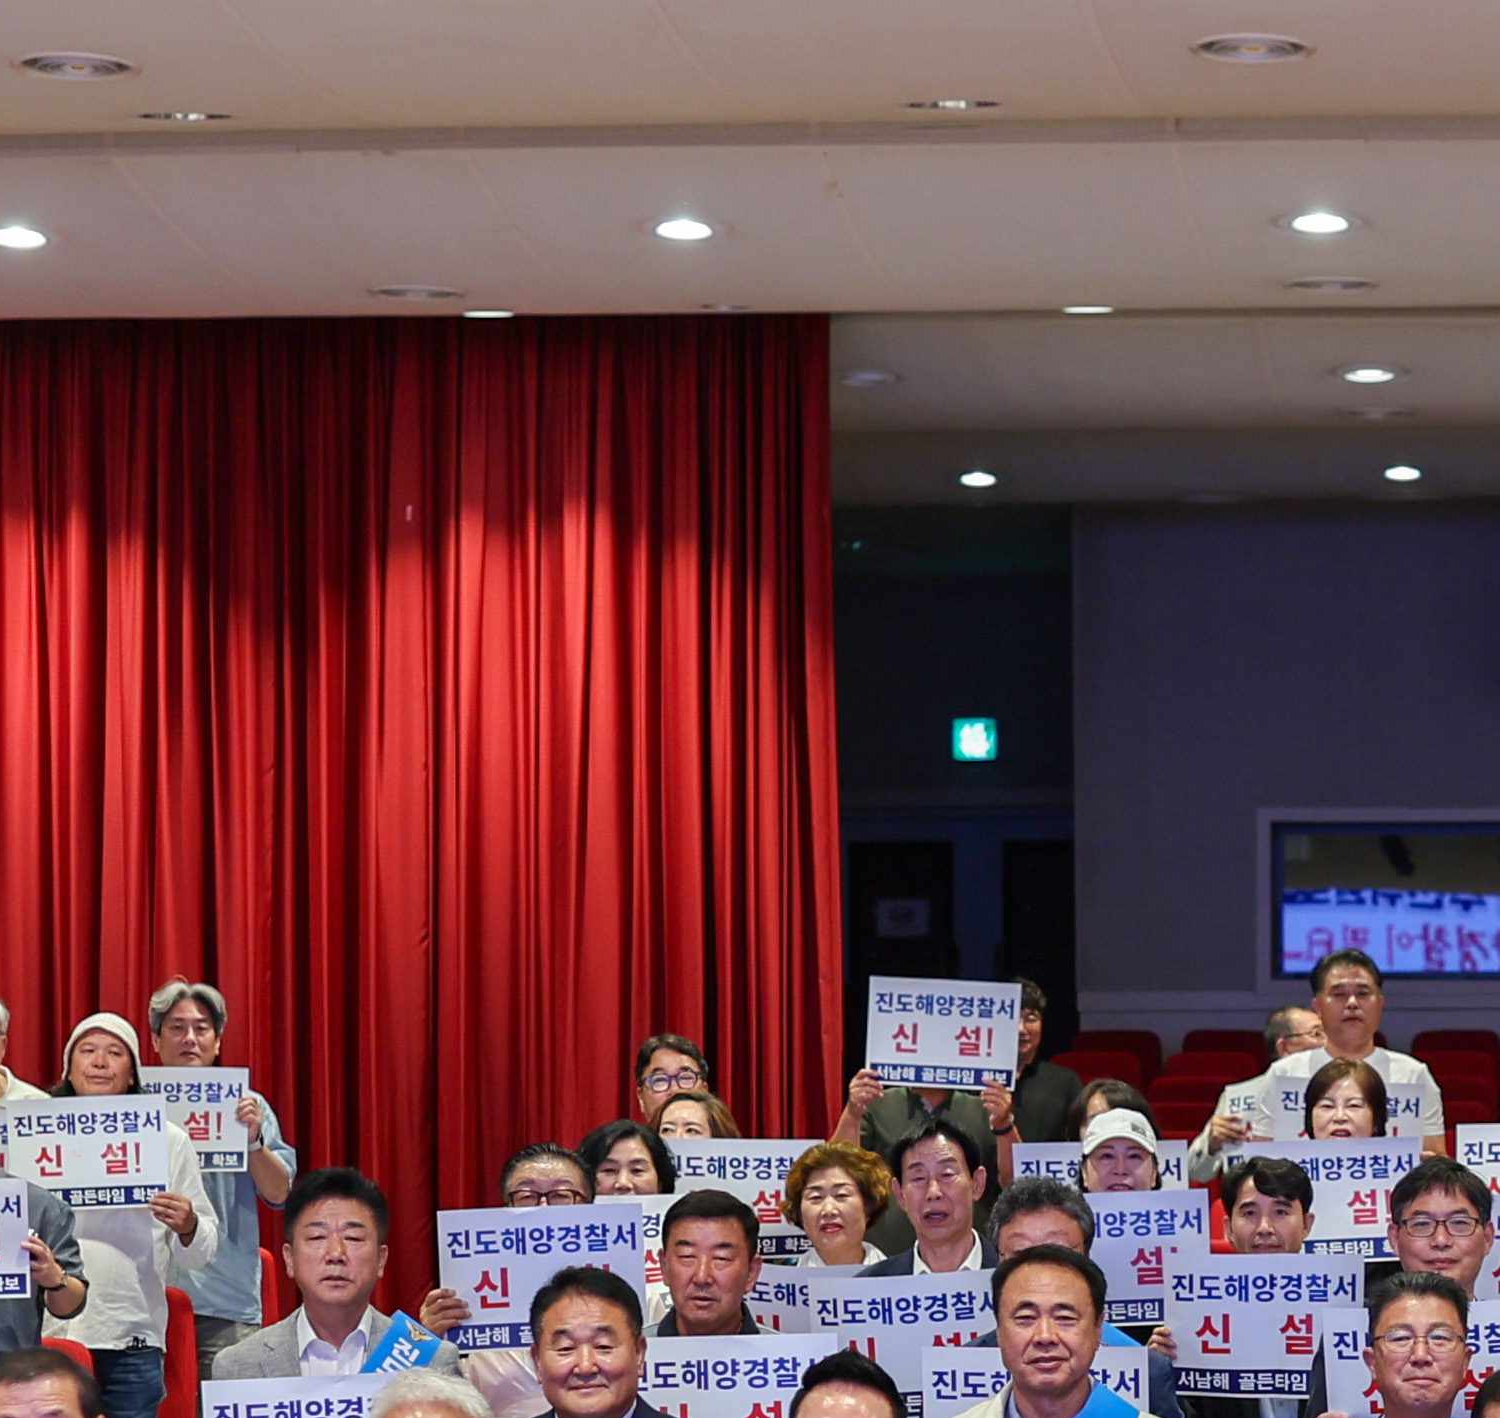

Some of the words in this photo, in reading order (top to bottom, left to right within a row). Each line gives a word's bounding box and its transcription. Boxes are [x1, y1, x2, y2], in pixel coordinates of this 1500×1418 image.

[875, 991, 1015, 1020] 진도해양경찰서
[891, 1022, 919, 1054] 신
[954, 1025, 994, 1057] 설!
[921, 1067, 975, 1084] 골든타임
[13, 1109, 161, 1138] 진도해양경찰서
[35, 1144, 63, 1177] 신
[100, 1141, 141, 1175] 설!
[69, 1188, 126, 1205] 골든타임
[446, 1221, 637, 1259] 진도해양경찰서
[1171, 1273, 1357, 1303] 진도해양경찰서
[455, 1326, 510, 1347] 서남해
[1177, 1370, 1230, 1391] 서남해
[1237, 1372, 1307, 1392] 골든타임
